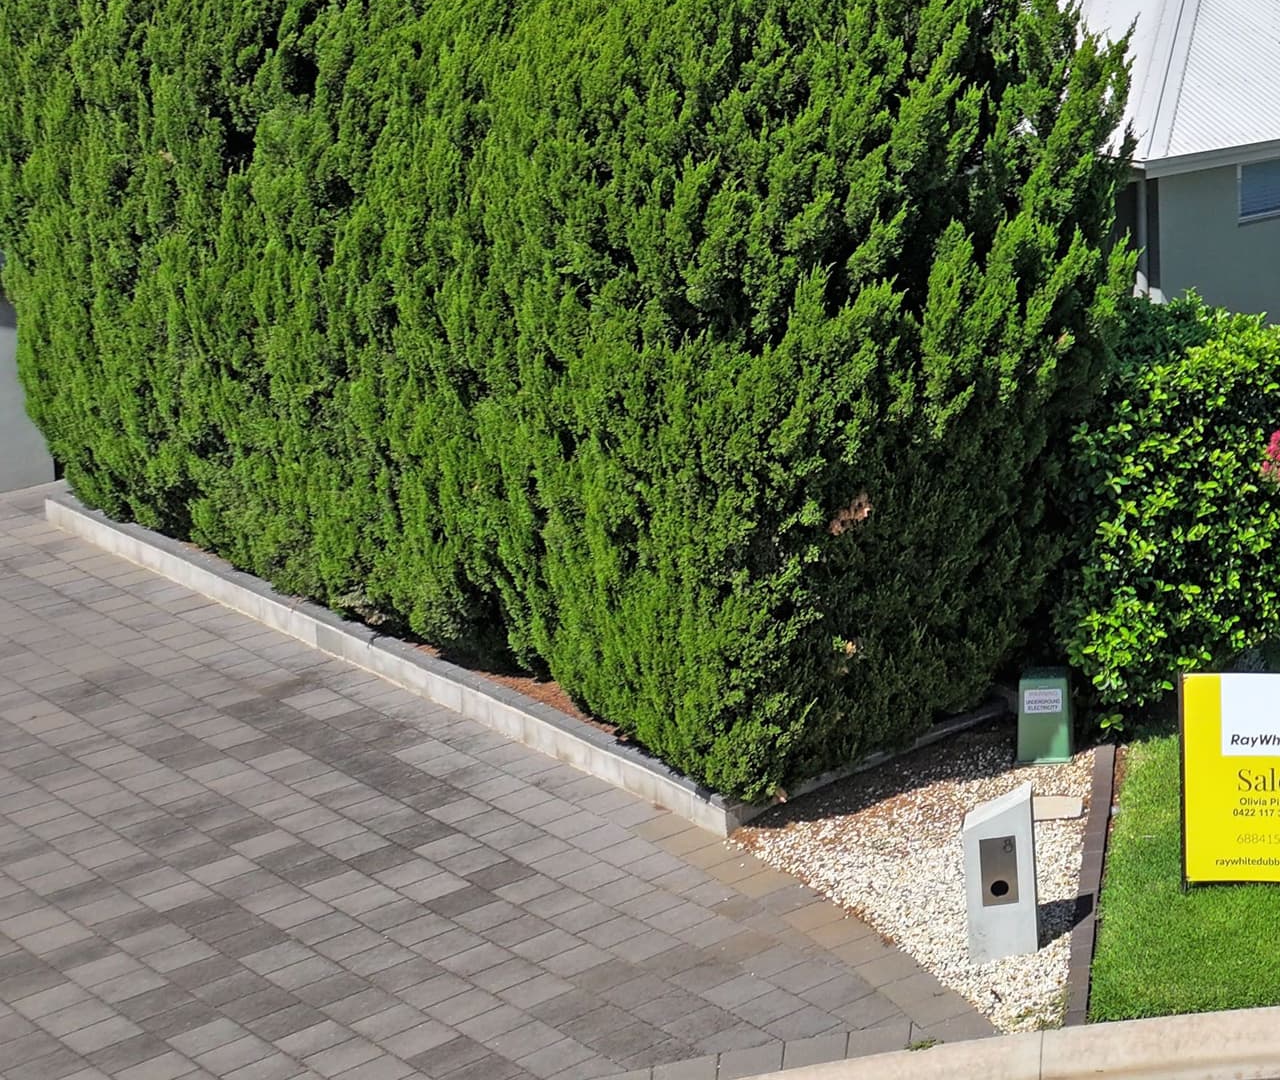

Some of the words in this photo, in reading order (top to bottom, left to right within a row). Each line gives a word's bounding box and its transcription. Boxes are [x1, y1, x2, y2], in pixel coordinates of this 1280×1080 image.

[1239, 797, 1267, 806] Olivia
[1232, 808, 1256, 817] 0422
[1259, 809, 1275, 817] 117
